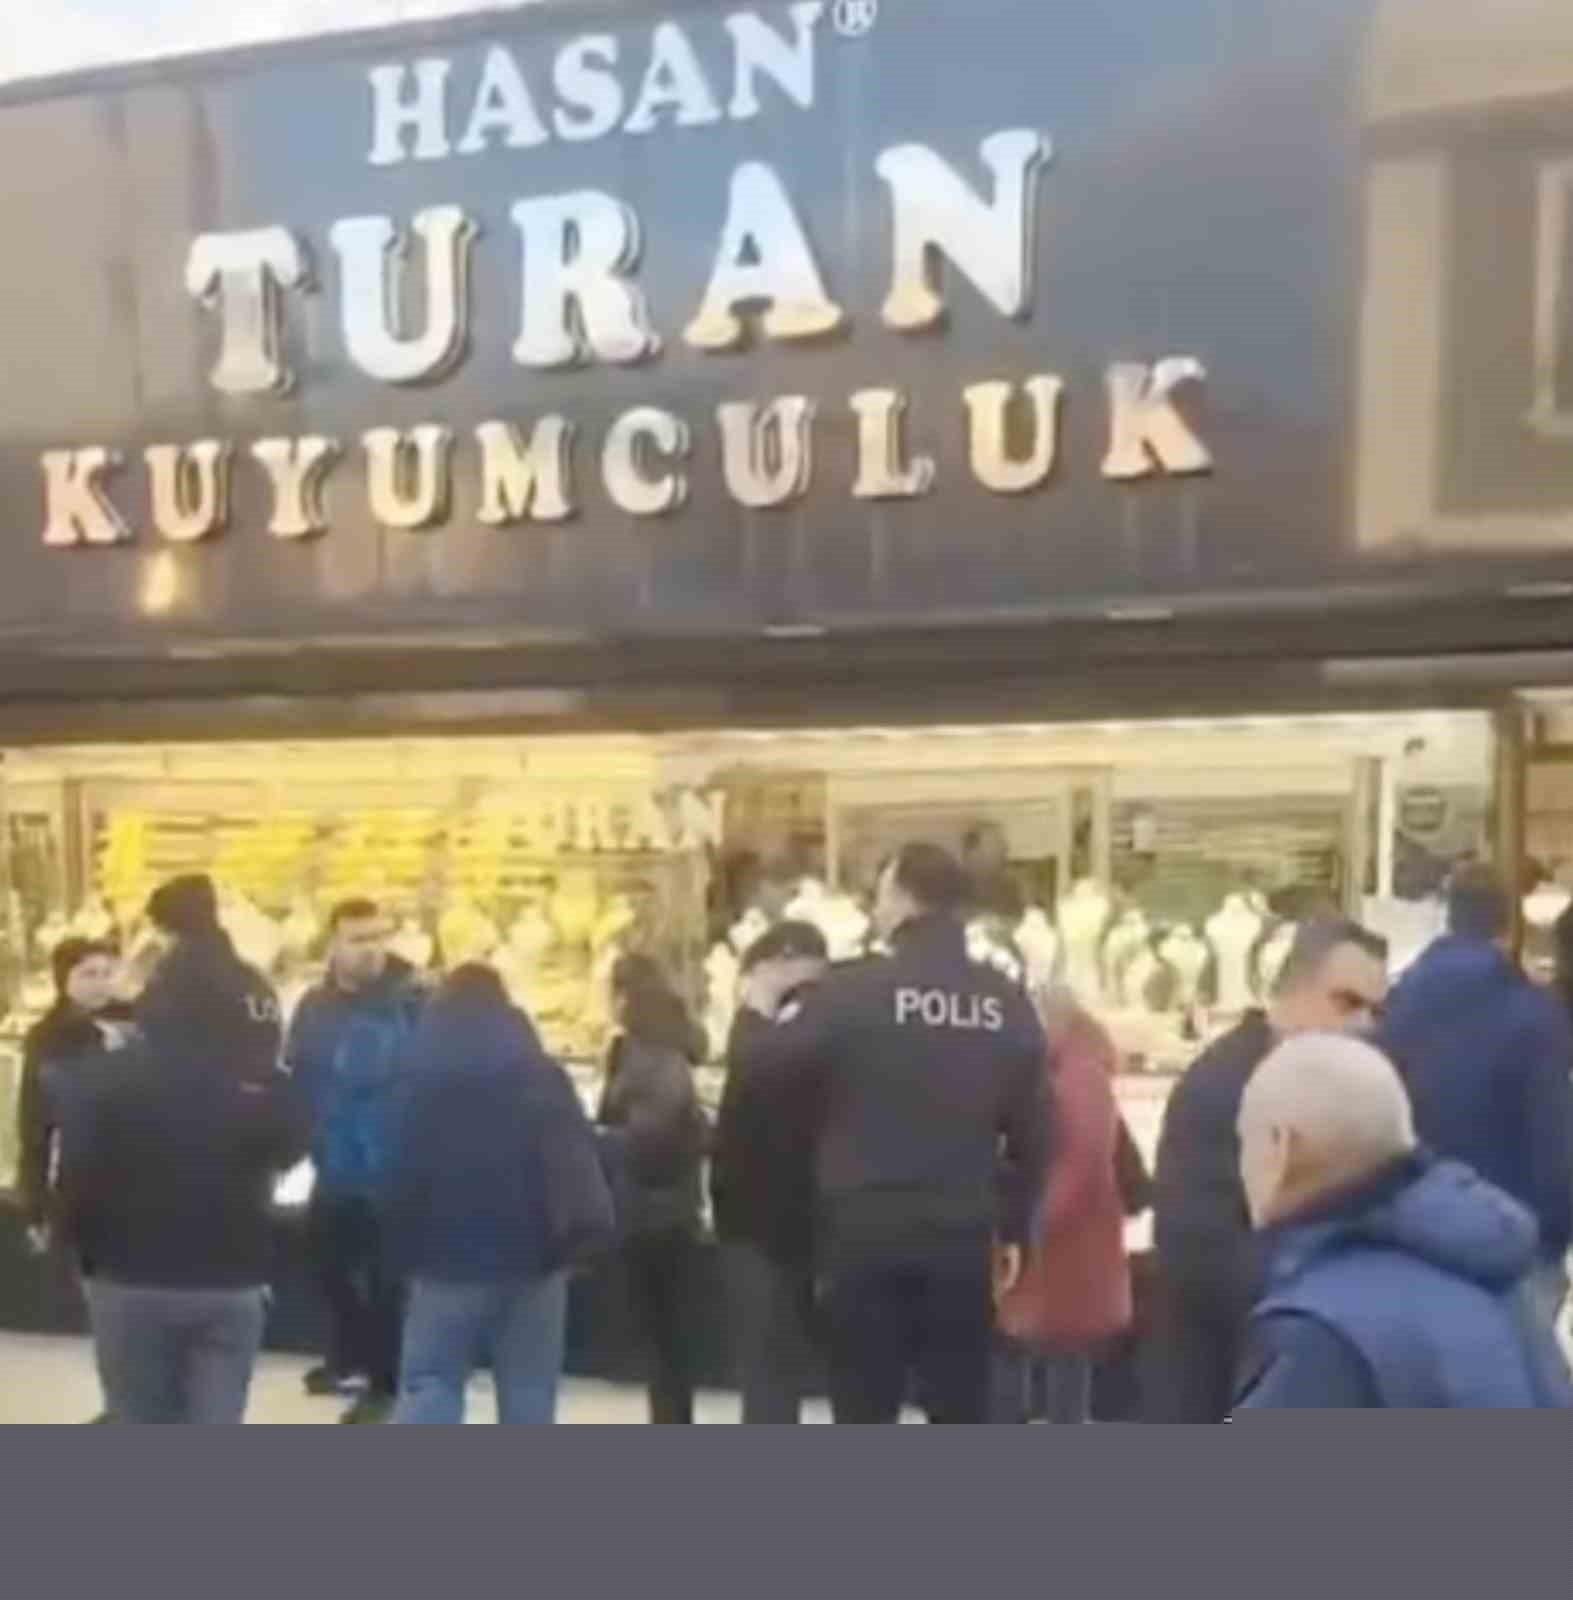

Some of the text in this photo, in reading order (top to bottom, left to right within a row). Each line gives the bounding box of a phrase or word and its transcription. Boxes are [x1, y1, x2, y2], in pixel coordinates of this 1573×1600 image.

[367, 1, 821, 165] HASAN
[186, 129, 1048, 393] TURAN
[41, 356, 1213, 546] KUYUMCULUK
